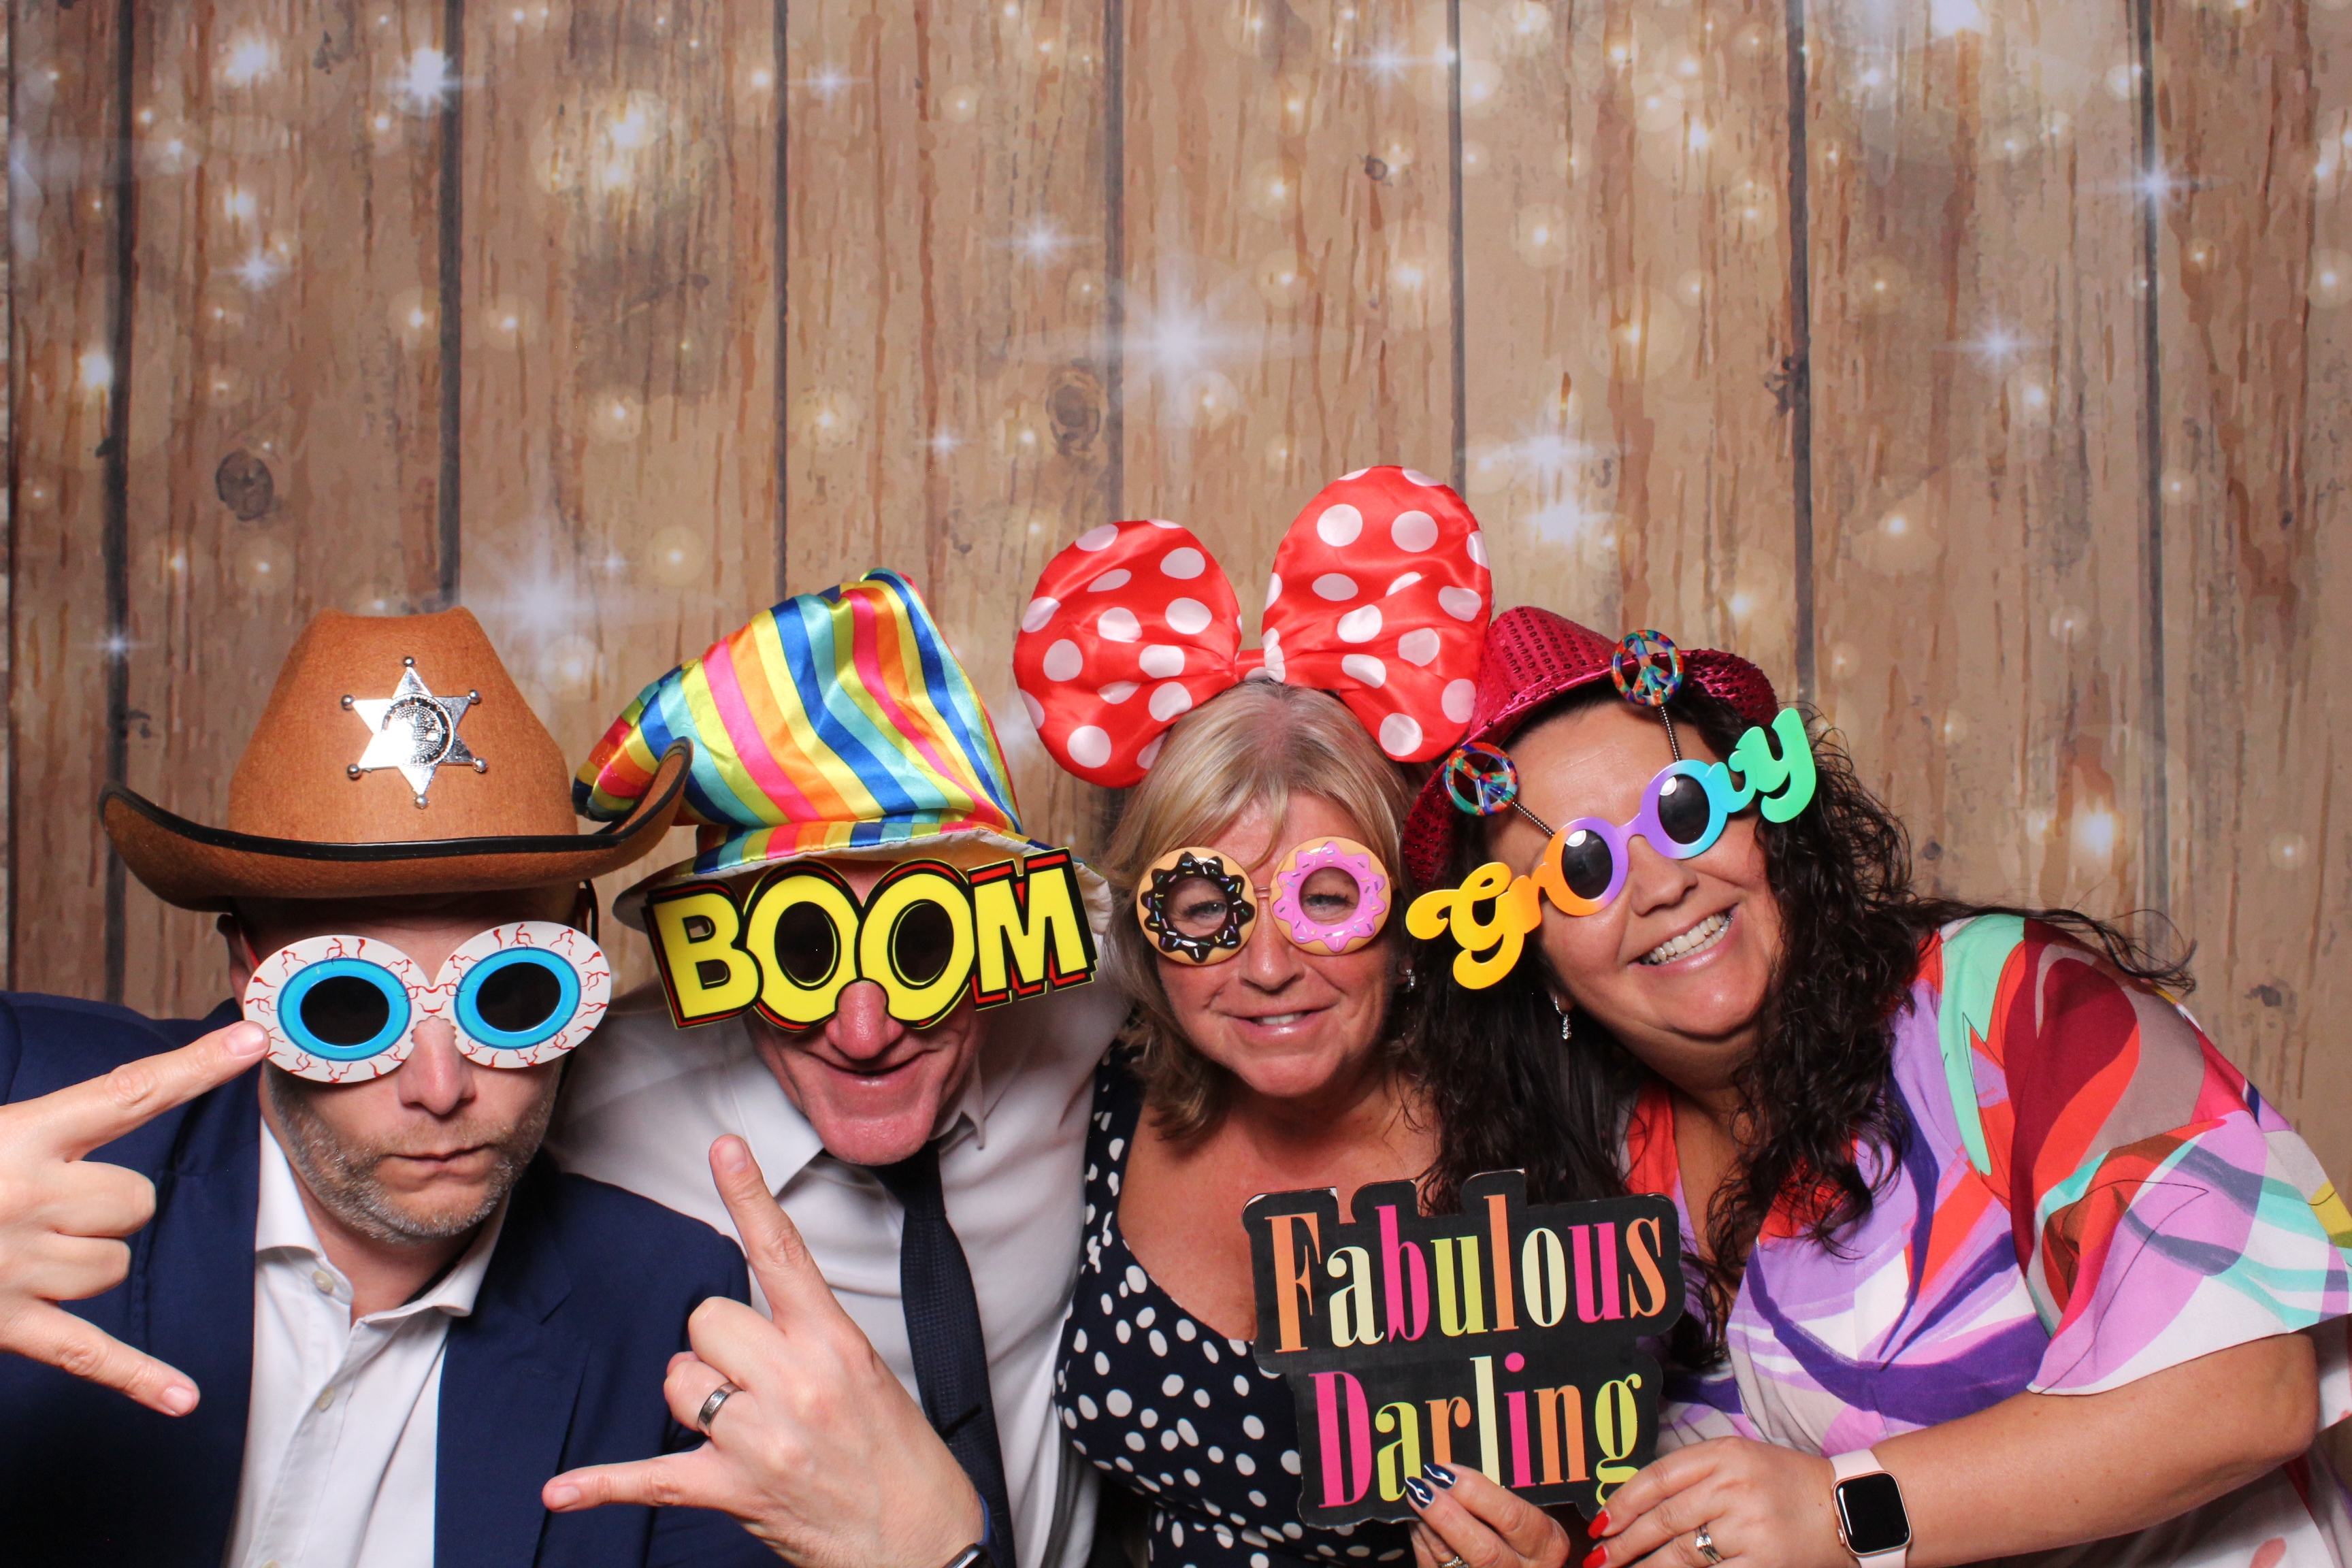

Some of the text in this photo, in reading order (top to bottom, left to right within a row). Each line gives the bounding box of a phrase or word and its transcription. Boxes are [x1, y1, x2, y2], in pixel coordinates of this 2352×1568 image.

[642, 848, 1097, 1030] BOOM
[1264, 1193, 1668, 1354] Fabulous
[1307, 1352, 1642, 1508] Darling
